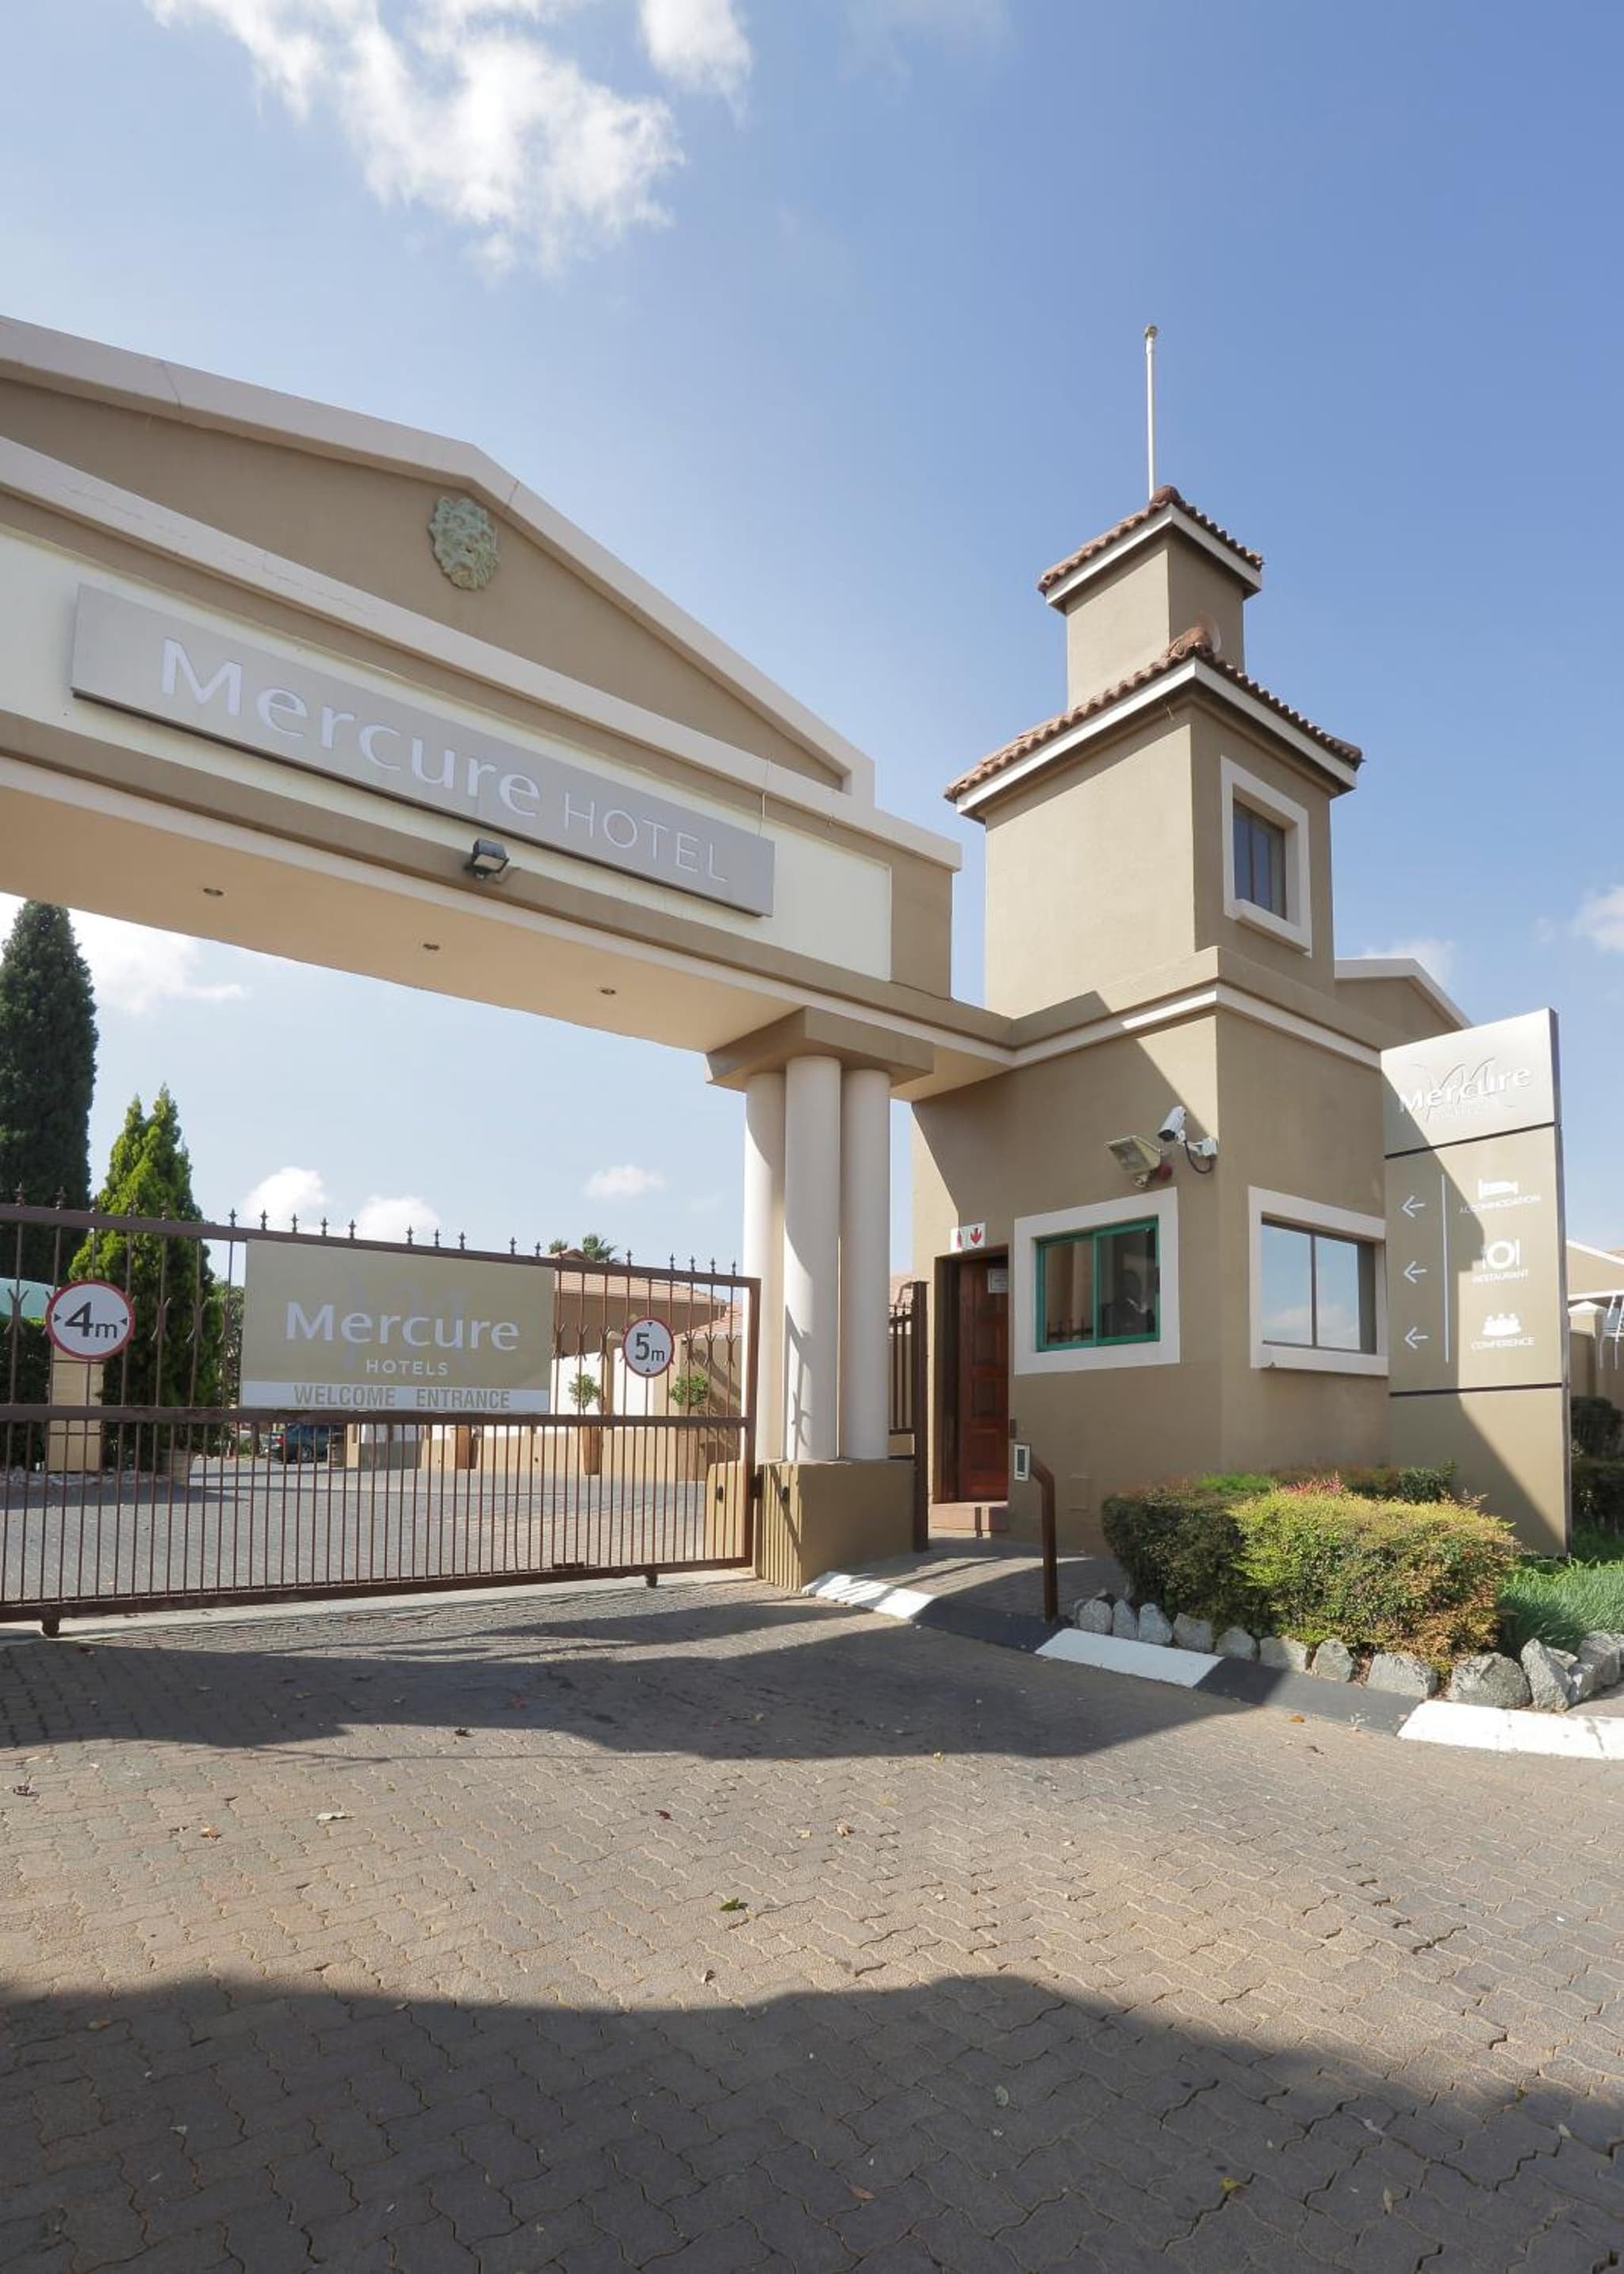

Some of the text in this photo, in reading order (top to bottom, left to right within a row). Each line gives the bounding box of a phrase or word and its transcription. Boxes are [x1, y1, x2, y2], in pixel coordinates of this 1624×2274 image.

[162, 638, 729, 882] Mercure HOTEL
[1399, 1067, 1532, 1112] Mercure
[285, 1302, 521, 1351] Mercure
[366, 1359, 448, 1376] HOTELS
[293, 1384, 511, 1409] WELCOME ENTRANCE
